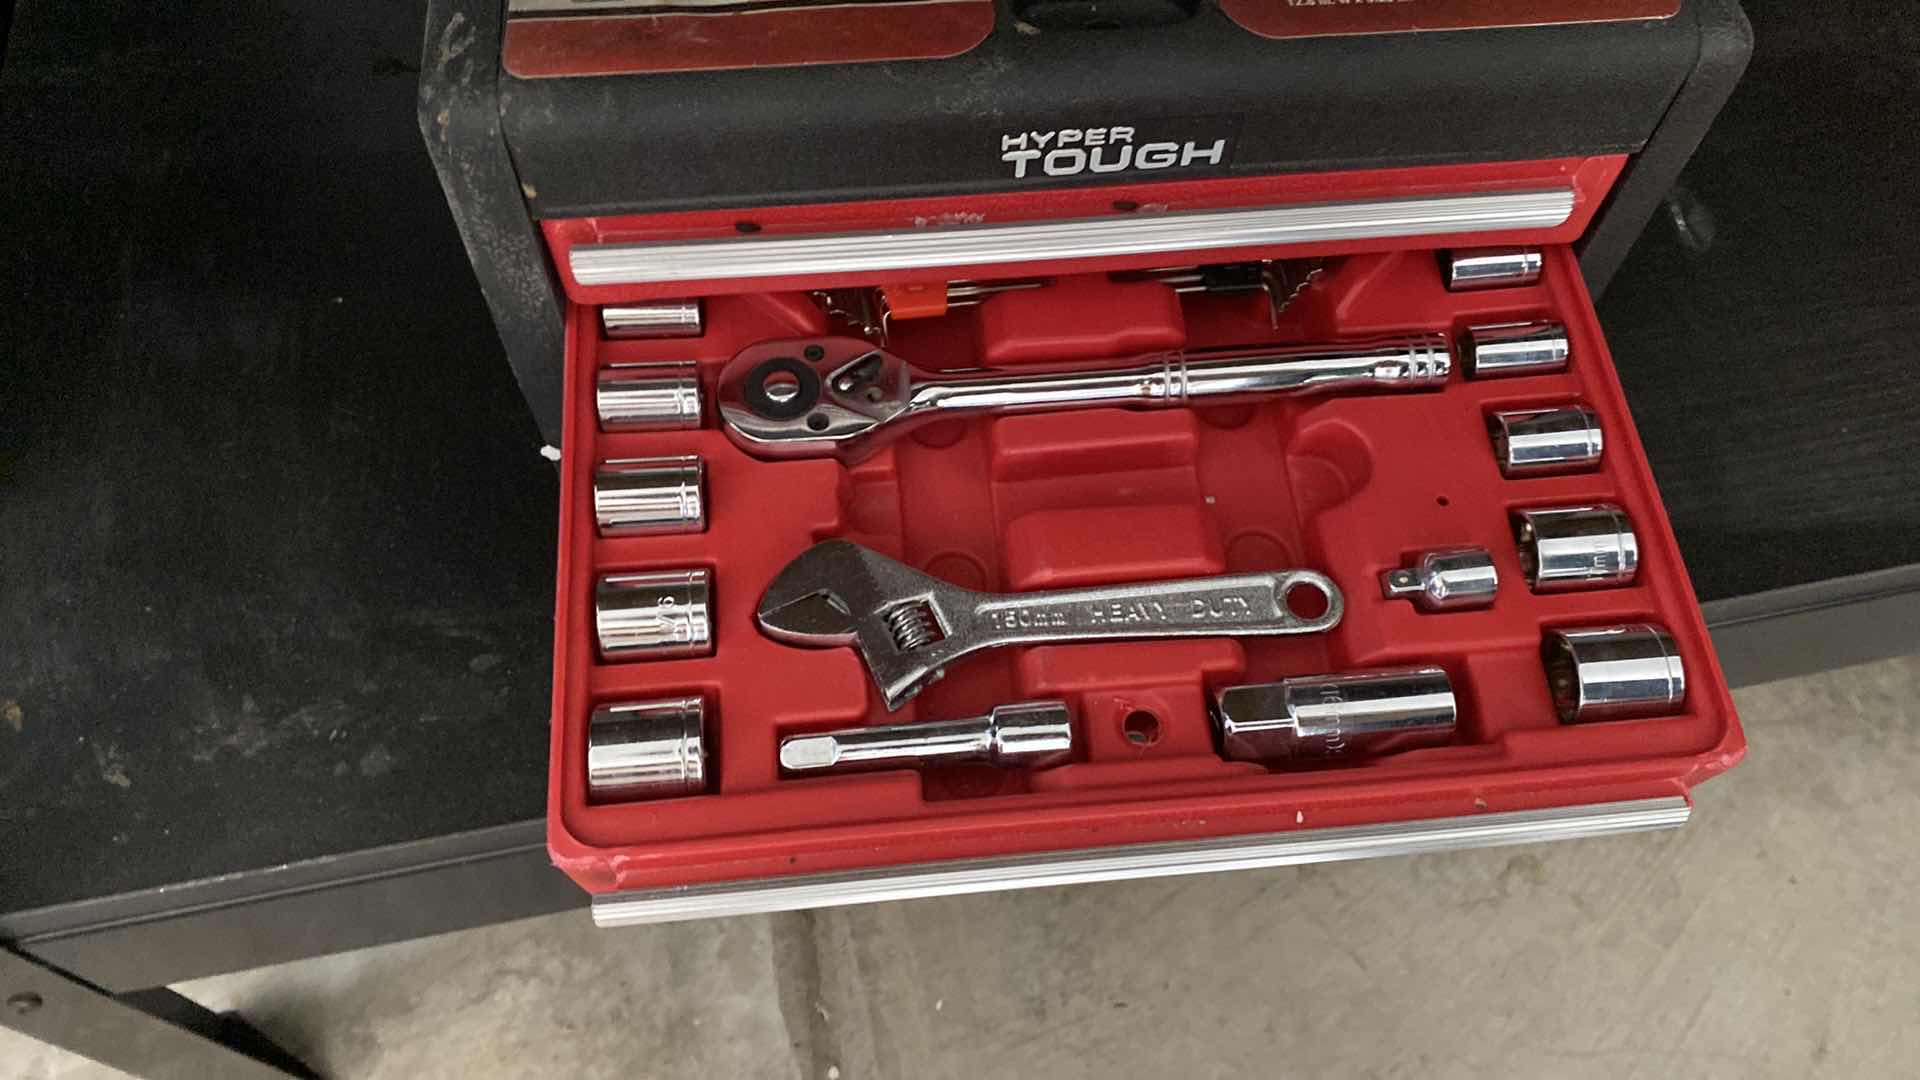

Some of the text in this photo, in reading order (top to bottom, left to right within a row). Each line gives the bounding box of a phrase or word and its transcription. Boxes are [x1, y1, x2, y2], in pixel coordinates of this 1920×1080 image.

[1001, 126, 1136, 151] HYPER
[1001, 139, 1226, 178] TOUGH
[1090, 601, 1167, 624] HEAVY
[1191, 596, 1252, 618] DUTY
